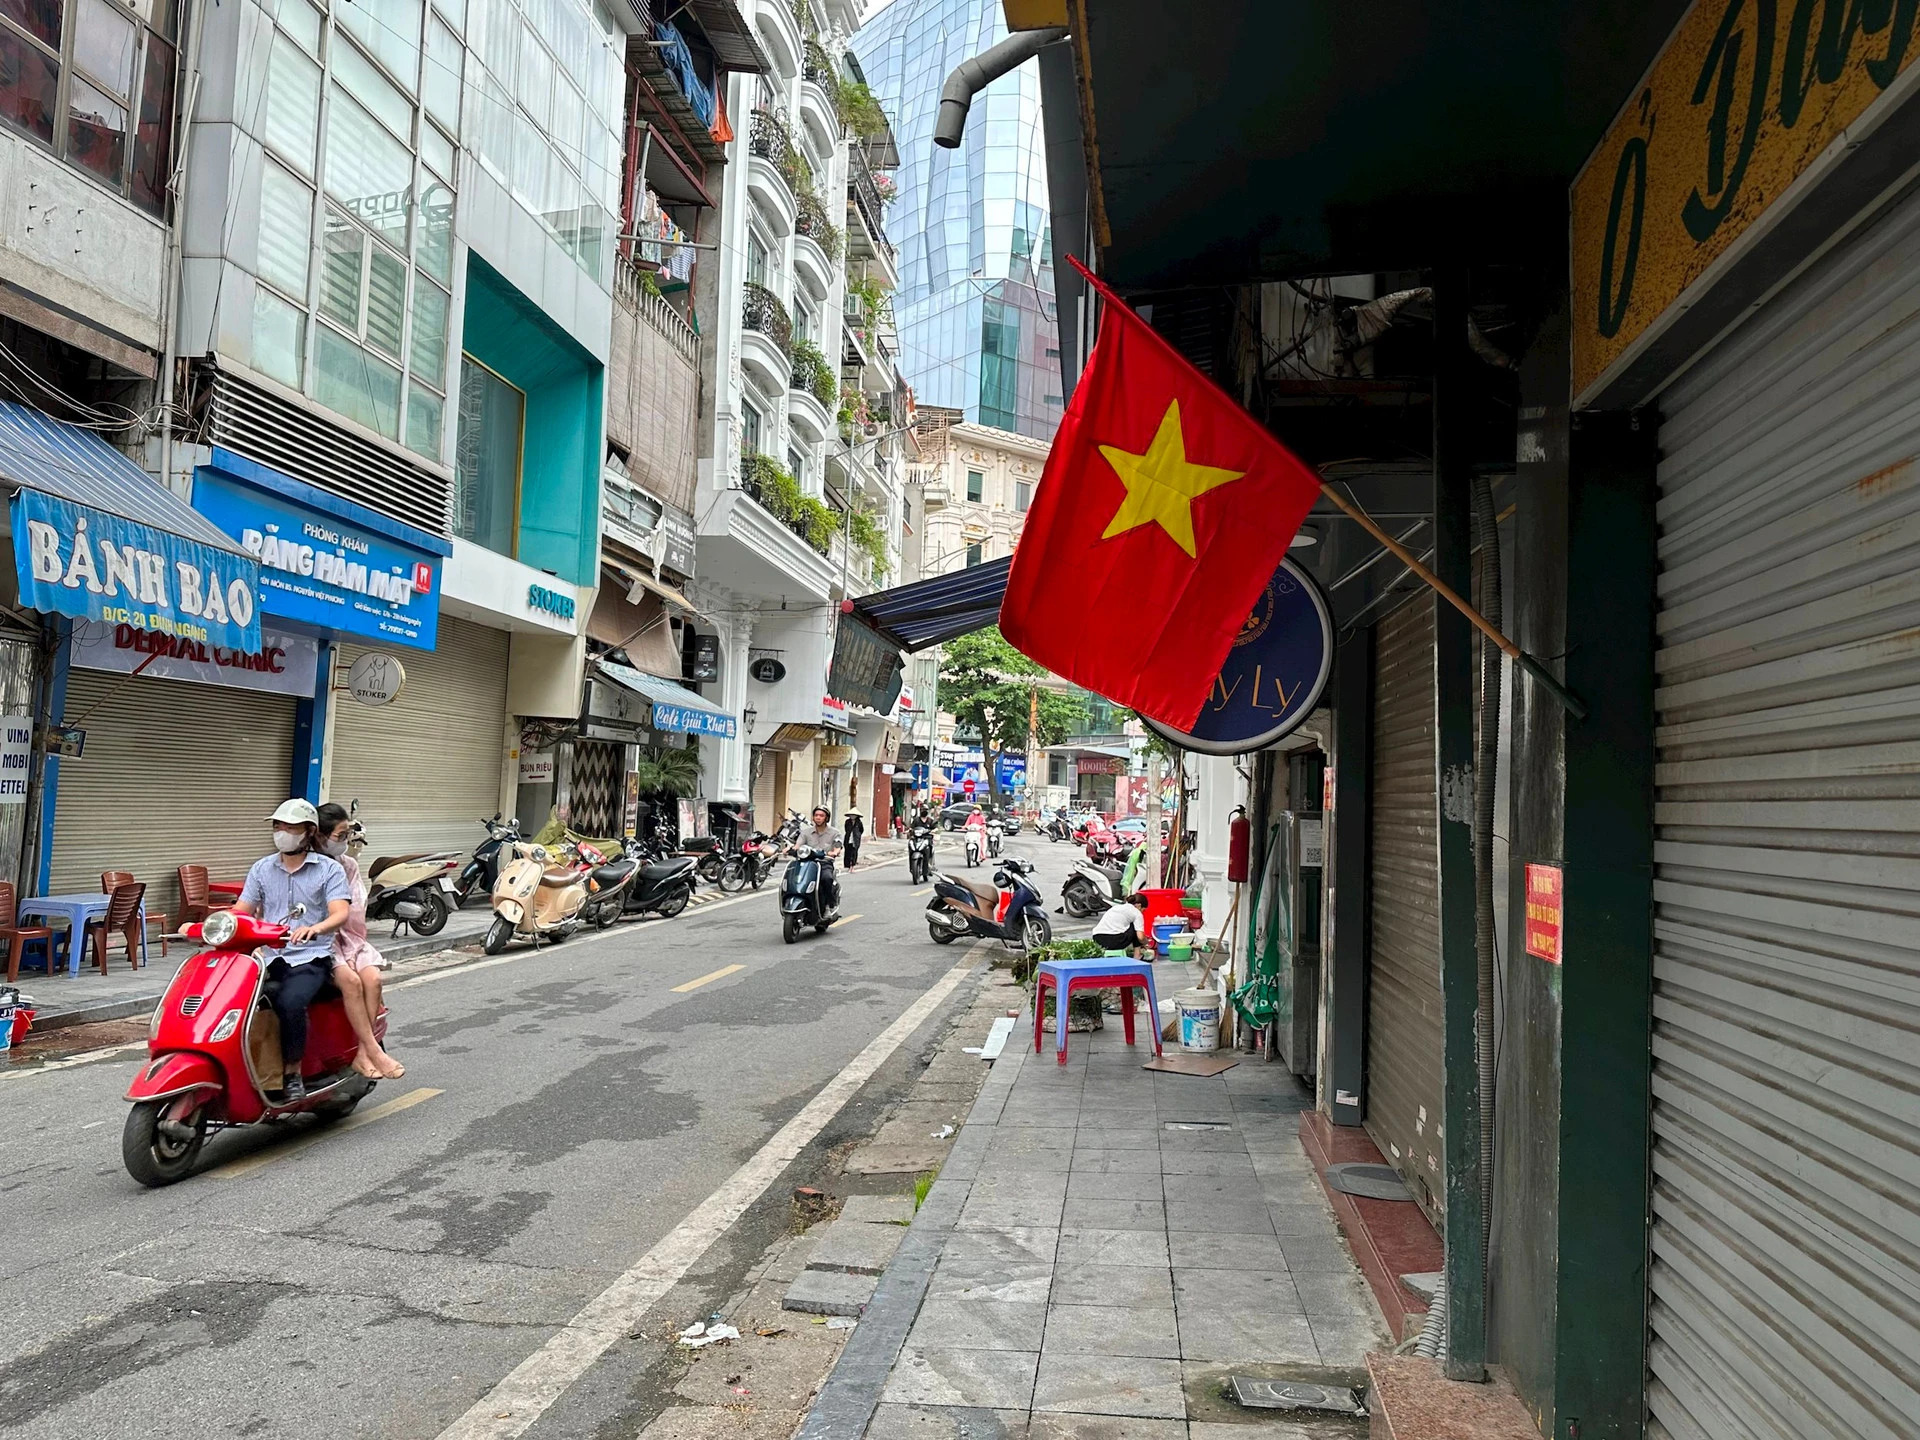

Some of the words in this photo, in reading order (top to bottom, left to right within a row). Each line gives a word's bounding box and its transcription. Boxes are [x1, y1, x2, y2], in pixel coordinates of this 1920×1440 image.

[304, 523, 339, 544] PHÒNG
[341, 535, 369, 555] KHÁM
[242, 524, 314, 577] RĂNG
[313, 549, 367, 594] HÀM
[368, 566, 414, 609] MẶT
[176, 561, 254, 628] BAO
[528, 584, 575, 619] STOKER
[133, 612, 147, 627] 20
[356, 689, 387, 699] STOKER
[1252, 665, 1301, 718] Ly
[7, 728, 29, 744] VINA
[2, 753, 28, 769] MOBI
[520, 763, 534, 773] BÚN
[536, 761, 552, 772] RIÊU
[1080, 759, 1107, 772] toong
[0, 779, 26, 794] ETTEL
